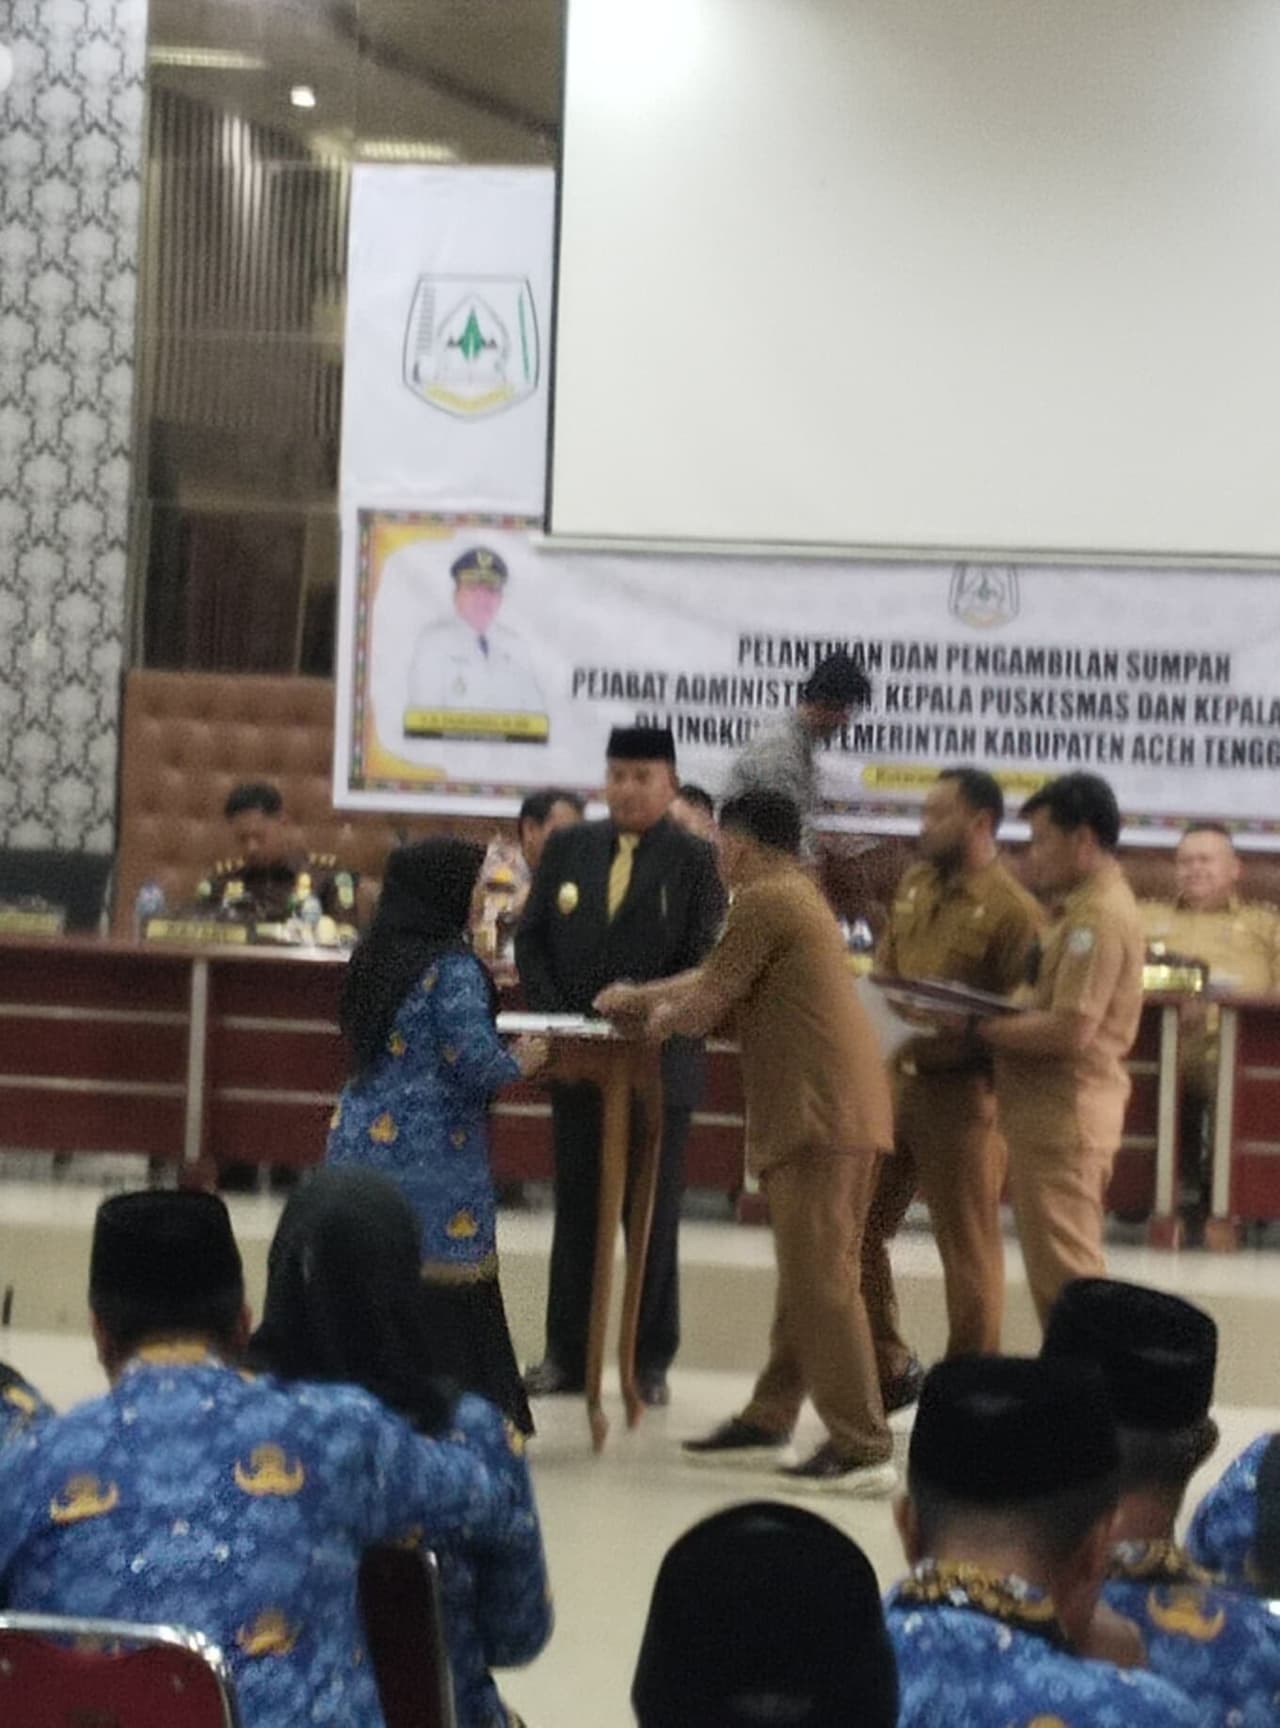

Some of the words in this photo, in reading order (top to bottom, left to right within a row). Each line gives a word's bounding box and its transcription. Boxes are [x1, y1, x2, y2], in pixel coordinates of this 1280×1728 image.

[890, 641, 939, 672] DAN
[945, 642, 1119, 681] PENGAMBILAN
[1126, 650, 1231, 685] SUMPAH
[572, 667, 668, 701] PEJABAT
[674, 672, 879, 712] ADMINISTR,
[886, 683, 973, 715] KEPALA
[979, 686, 1130, 722] PUSKESMAS
[1137, 691, 1187, 724] DAN
[983, 726, 1125, 762] KABUPATEN
[1131, 732, 1195, 767] ACEH
